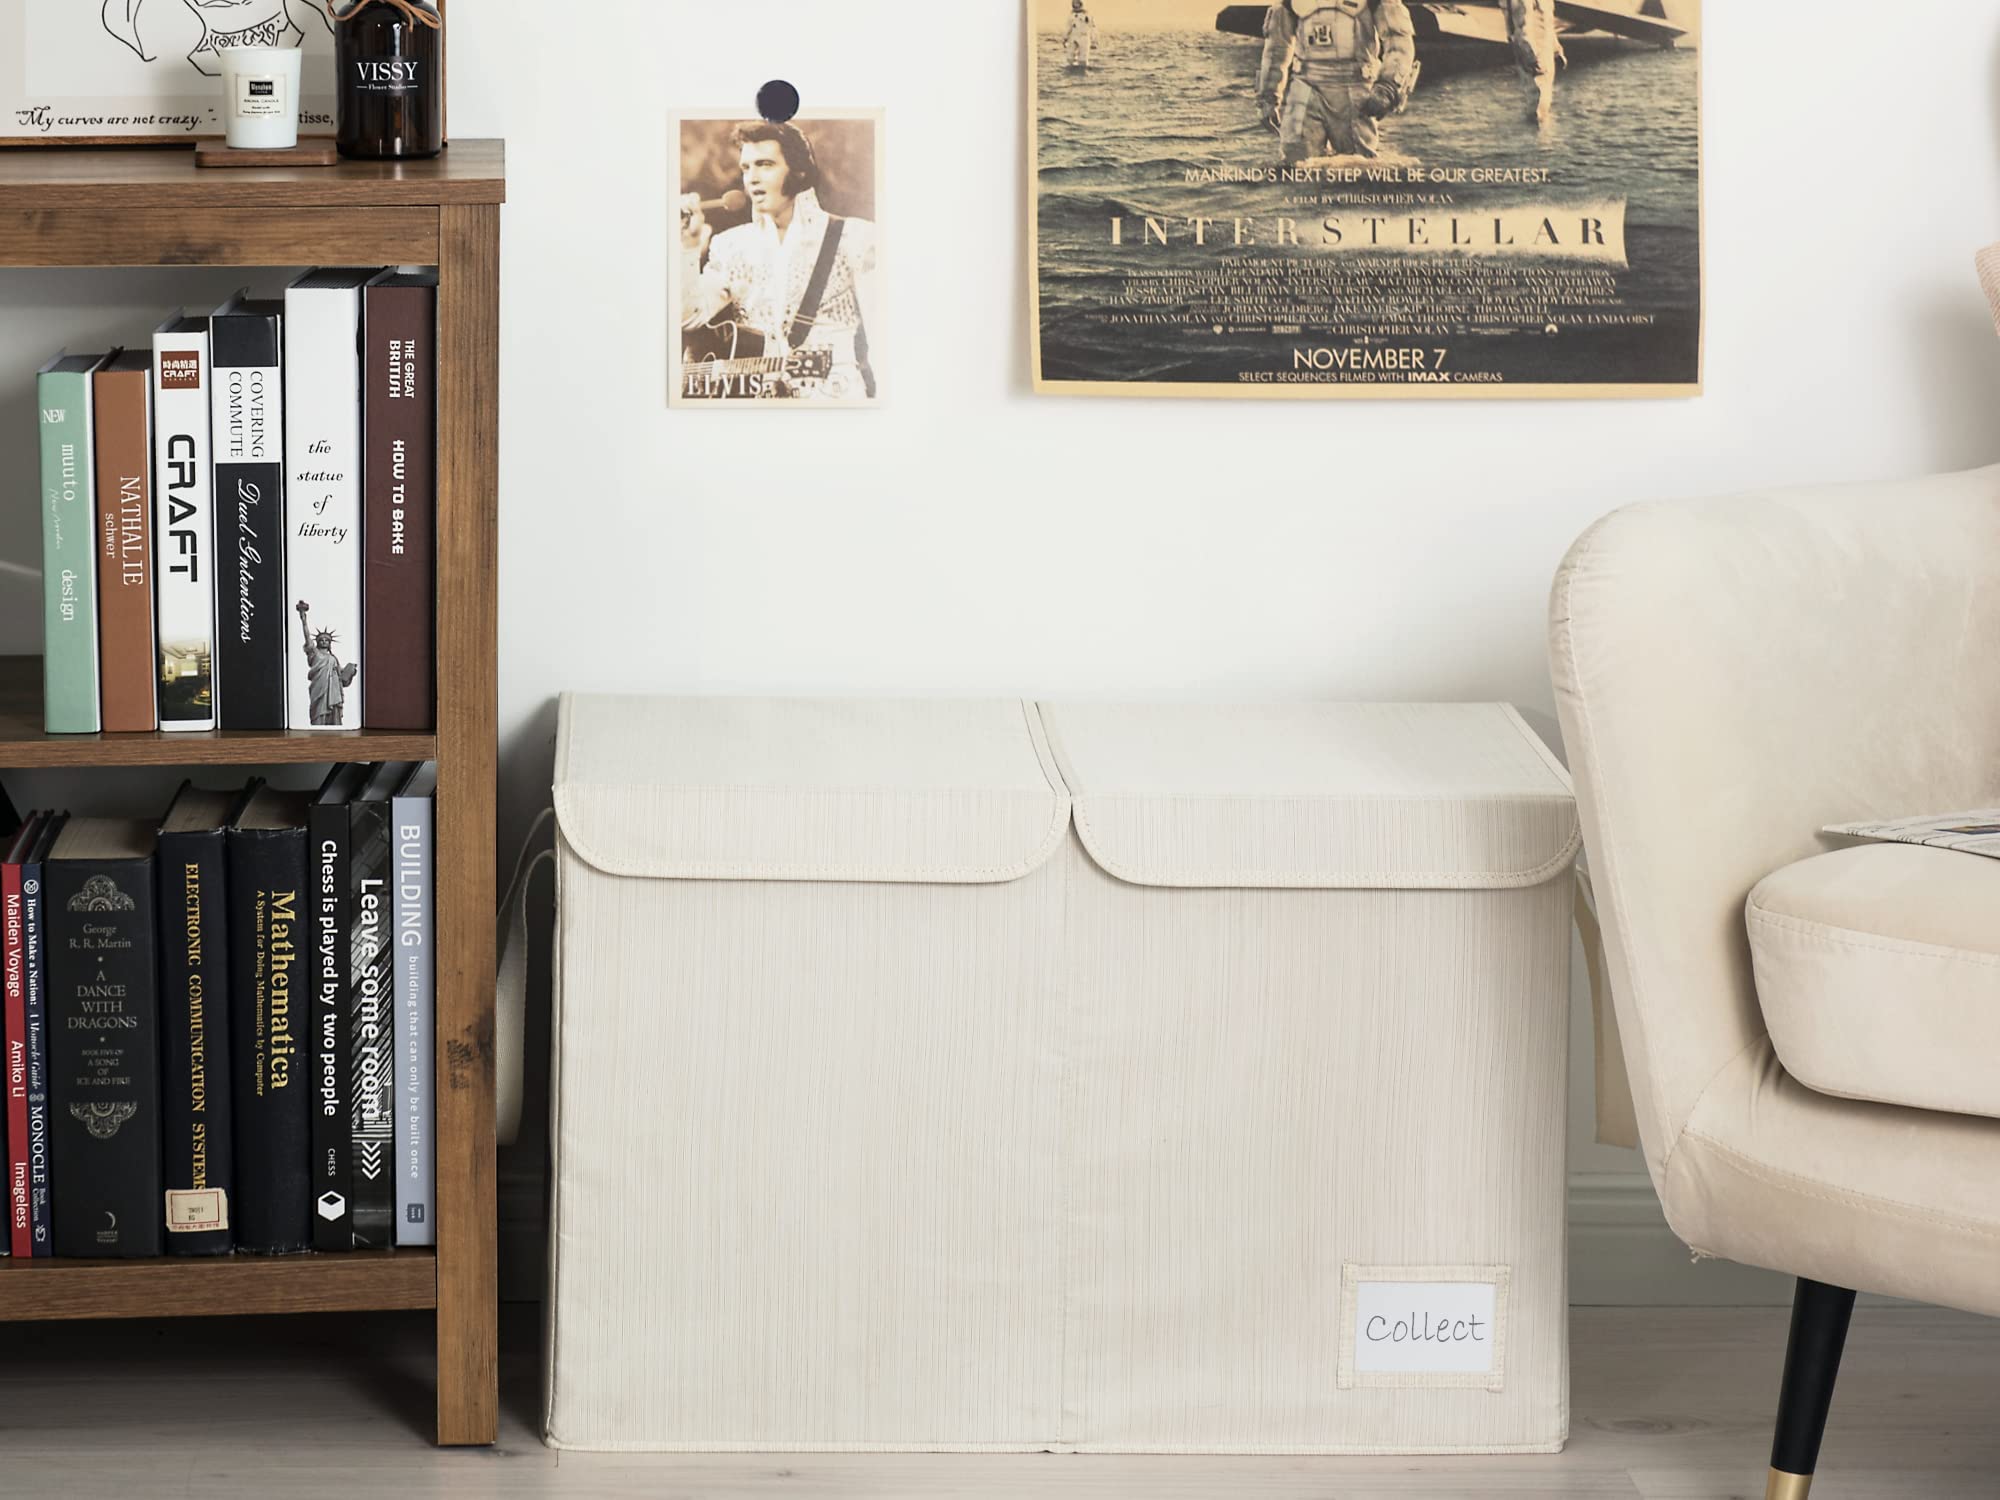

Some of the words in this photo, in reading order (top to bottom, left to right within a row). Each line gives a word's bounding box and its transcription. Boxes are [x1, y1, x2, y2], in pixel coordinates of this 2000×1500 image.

[356, 62, 418, 80] VISSY
[58, 116, 103, 125] curves
[107, 116, 129, 125] are
[132, 115, 155, 125] not
[1184, 168, 1277, 183] MANKIND'S
[1281, 168, 1323, 182] NEXT
[1326, 168, 1362, 182] STEP
[1366, 168, 1402, 182] WILL
[1407, 168, 1426, 182] BE
[1430, 168, 1466, 182] OUR
[1470, 168, 1552, 183] GREATEST.
[1110, 216, 1605, 246] INTERSTELLAR
[404, 339, 415, 359] THE
[1294, 348, 1425, 369] NOVEMBER
[1433, 348, 1447, 369] 7
[163, 370, 198, 378] CRAFT
[390, 340, 400, 398] BRITISH
[404, 362, 415, 398] GREAT
[1239, 372, 1273, 382] SELECT
[1276, 372, 1338, 382] SEQUENCES
[1340, 372, 1376, 382] FILMED
[1378, 372, 1405, 382] WITH
[1408, 372, 1450, 382] IMAX
[1454, 372, 1503, 382] CAMERAS
[687, 374, 761, 395] ELVIS
[42, 408, 66, 424] NEW
[229, 371, 244, 457] COMMUTE
[250, 371, 264, 458] COVERING
[308, 440, 332, 454] the
[392, 440, 404, 480] HOW
[61, 444, 79, 501] muuto
[296, 471, 344, 481] statue
[168, 434, 198, 582] CRAFT
[238, 478, 261, 538] Duel
[312, 494, 333, 516] of
[392, 484, 404, 504] TO
[105, 512, 118, 559] schwer
[120, 476, 144, 586] NATHALIE
[298, 522, 348, 544] liberty
[392, 508, 404, 554] BAKE
[60, 569, 78, 621] design
[321, 840, 338, 894] Chess
[257, 890, 265, 898] A
[400, 825, 422, 947] BUILDING
[7, 894, 21, 945] Maiden
[27, 899, 36, 920] How
[186, 863, 202, 966] ELECTRONIC
[256, 900, 266, 932] System
[322, 898, 338, 912] is
[360, 879, 384, 958] Leave
[28, 923, 36, 933] to
[82, 923, 117, 937] George
[256, 934, 265, 948] for
[28, 935, 38, 961] Make
[69, 938, 81, 949] R.
[83, 938, 95, 949] R.
[98, 938, 132, 949] Martin
[319, 917, 338, 978] played
[6, 948, 22, 998] Voyage
[96, 970, 106, 982] A
[256, 952, 265, 978] Doing
[29, 970, 39, 1006] Nation:
[77, 984, 126, 998] DANCE
[271, 890, 296, 1090] Mathematica
[320, 983, 339, 1006] by
[407, 956, 419, 1008] building
[81, 1001, 123, 1013] WITH
[256, 980, 265, 1036] Mathematics
[361, 965, 380, 1039] some
[68, 1016, 138, 1030] DRAGONS
[323, 1012, 338, 1049] two
[410, 1012, 418, 1037] that
[189, 974, 206, 1112] COMMUNICATION
[254, 1039, 264, 1050] by
[11, 1040, 25, 1083] Amiko
[255, 1053, 264, 1096] Computer
[12, 1087, 25, 1097] Li
[320, 1053, 340, 1116] people
[361, 1047, 380, 1119] room
[408, 1066, 420, 1093] only
[410, 1097, 420, 1112] be
[32, 1106, 45, 1184] MONOCLE
[410, 1116, 420, 1145] built
[328, 1148, 336, 1177] CHESS
[410, 1150, 418, 1178] once
[13, 1162, 29, 1229] Imageless
[1366, 1311, 1486, 1343] Collect
